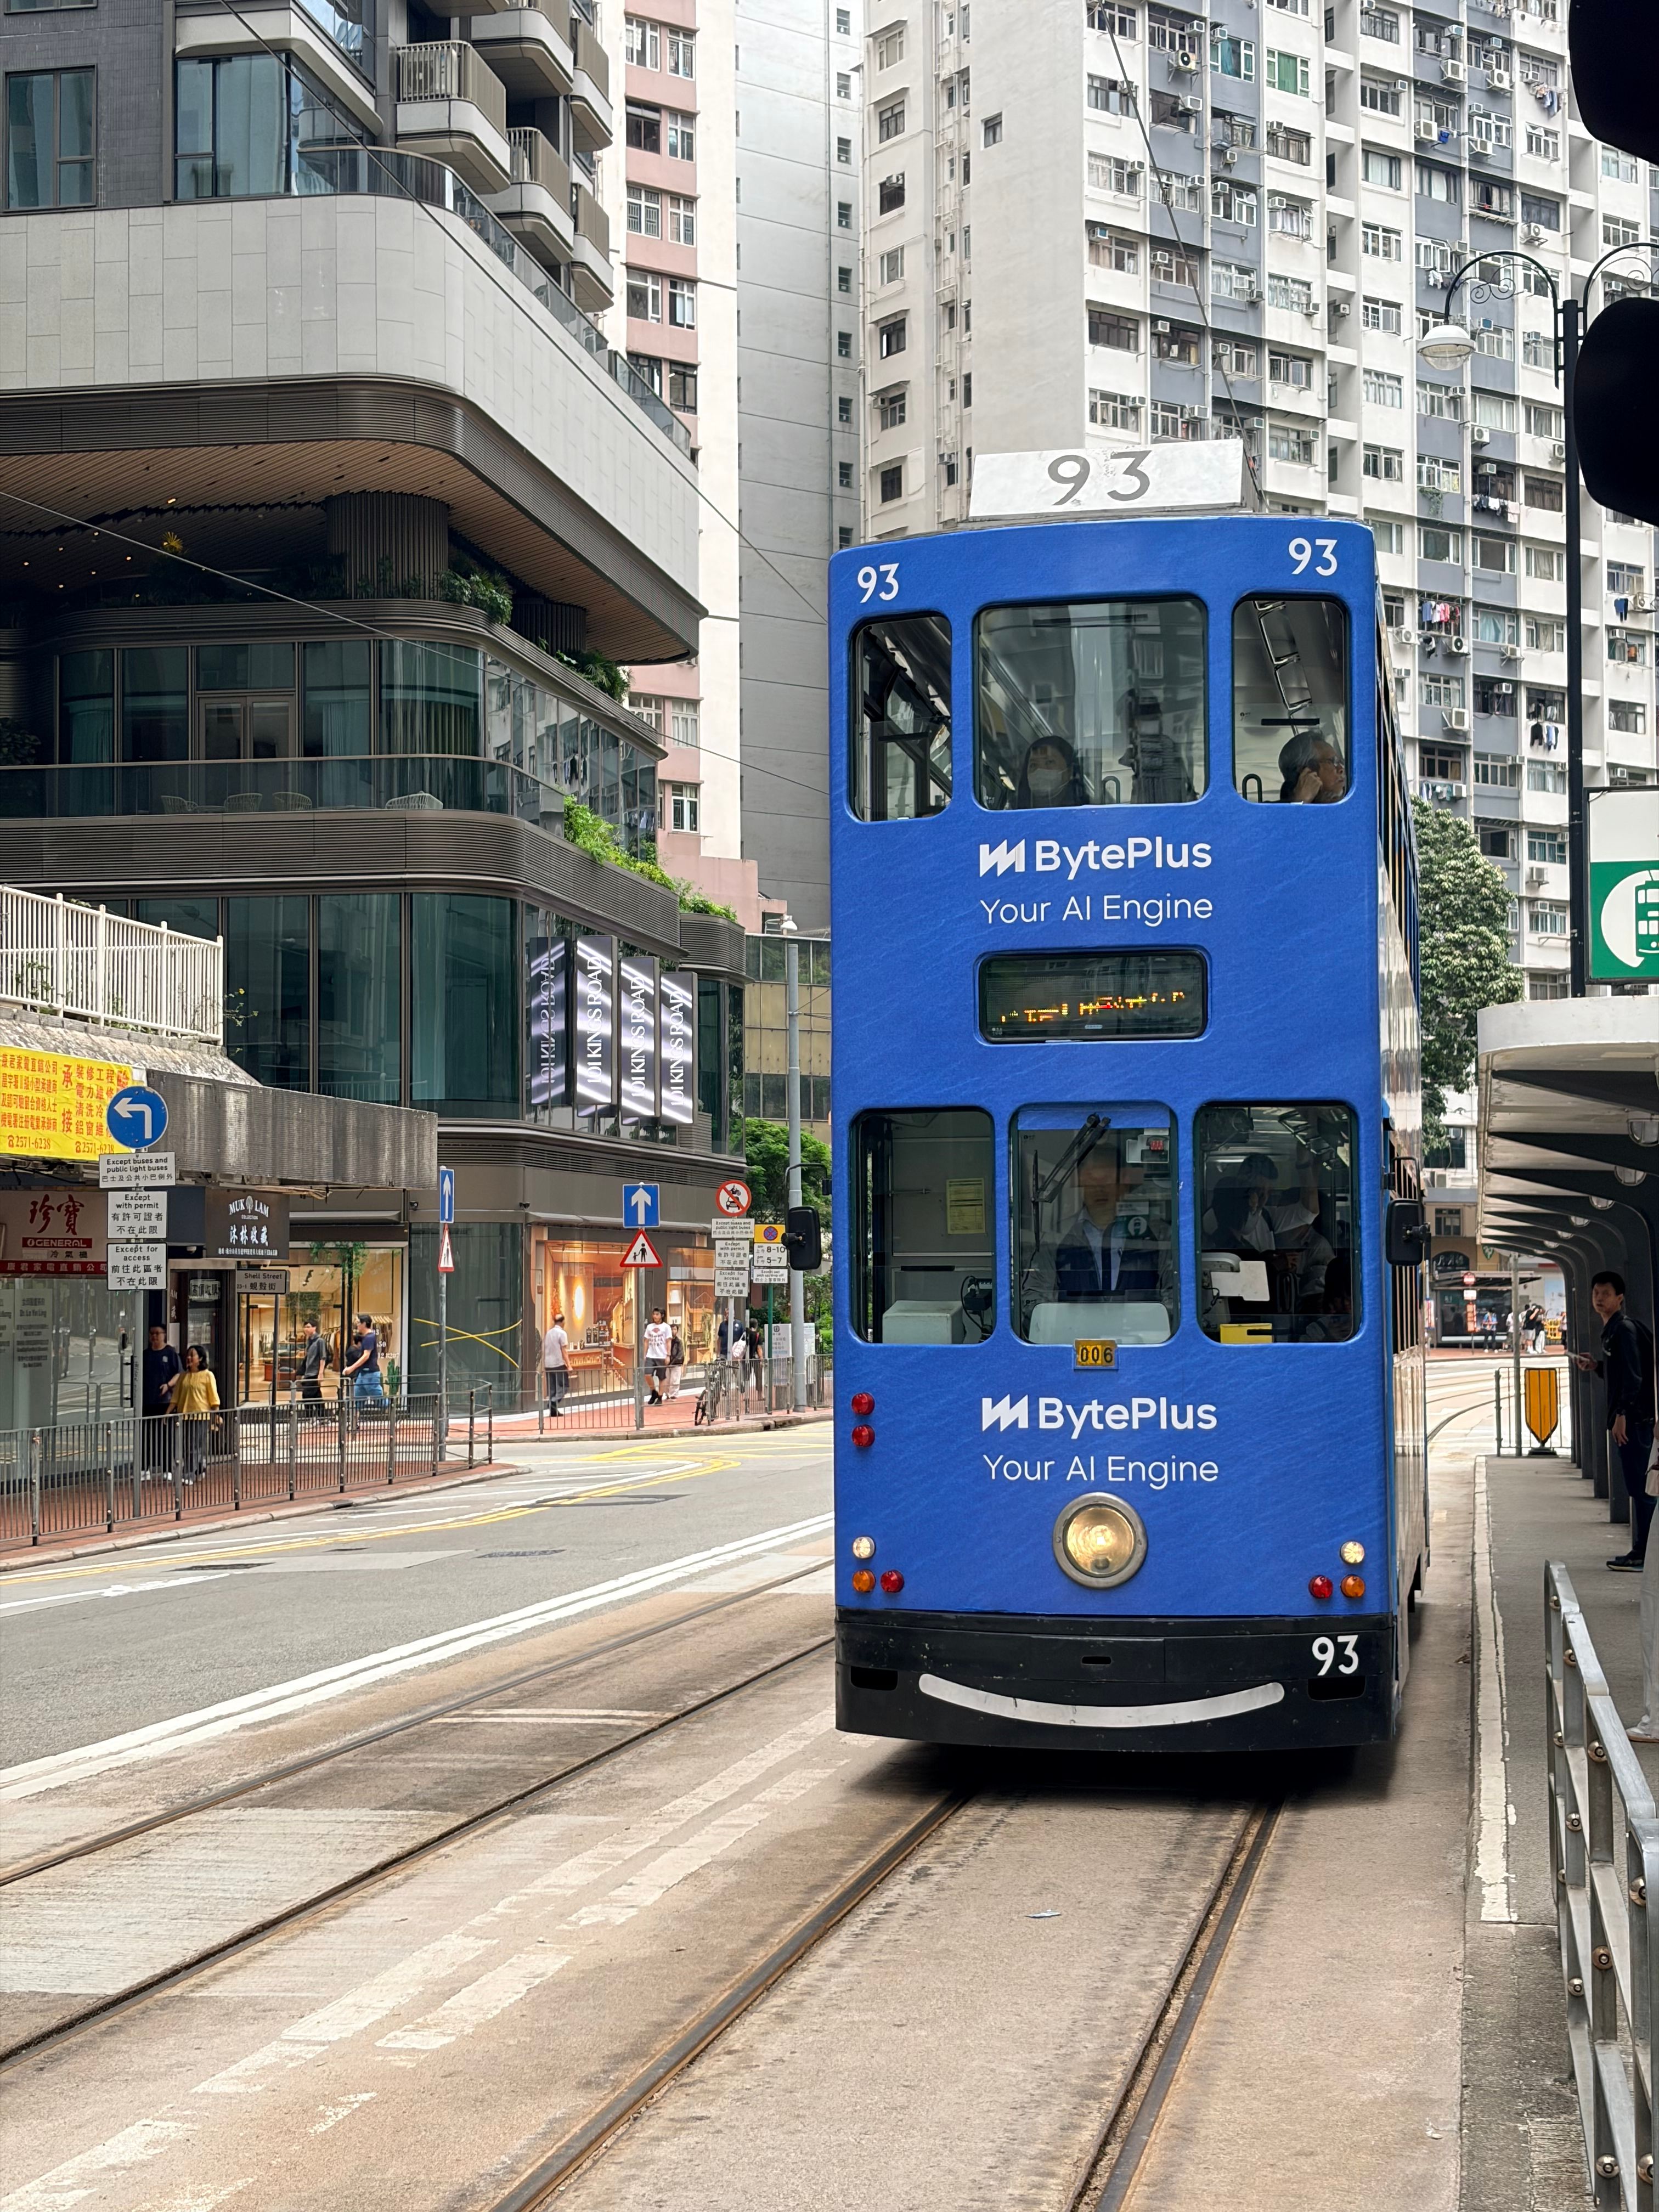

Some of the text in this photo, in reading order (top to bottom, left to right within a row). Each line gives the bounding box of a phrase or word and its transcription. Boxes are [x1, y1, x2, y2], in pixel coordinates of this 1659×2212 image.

[1048, 450, 1151, 506] 93
[1289, 538, 1338, 576] 93
[857, 563, 899, 603] 93
[1036, 836, 1212, 880] BytePlus
[980, 893, 1212, 927] Your AI Engine
[587, 957, 602, 1083] 101 KINGS ROAD
[631, 976, 645, 1097] 101 KINGS ROAD
[670, 991, 684, 1105] 101 KINGS ROAD
[15, 1136, 51, 1150] 2571-6238
[102, 1173, 173, 1182] 巴士及公共小巴例外
[30, 1194, 84, 1235] 珍寶
[111, 1212, 163, 1221] 有許可證者
[229, 1199, 269, 1217] MUK LAM
[116, 1226, 157, 1234] 不在此限
[111, 1264, 163, 1273] 前往此區者
[116, 1277, 157, 1286] 不在此限
[1080, 1346, 1113, 1363] 006
[1039, 1397, 1217, 1440] BytePlus
[983, 1454, 1218, 1490] Your AI Engine
[1312, 1635, 1359, 1676] 93
